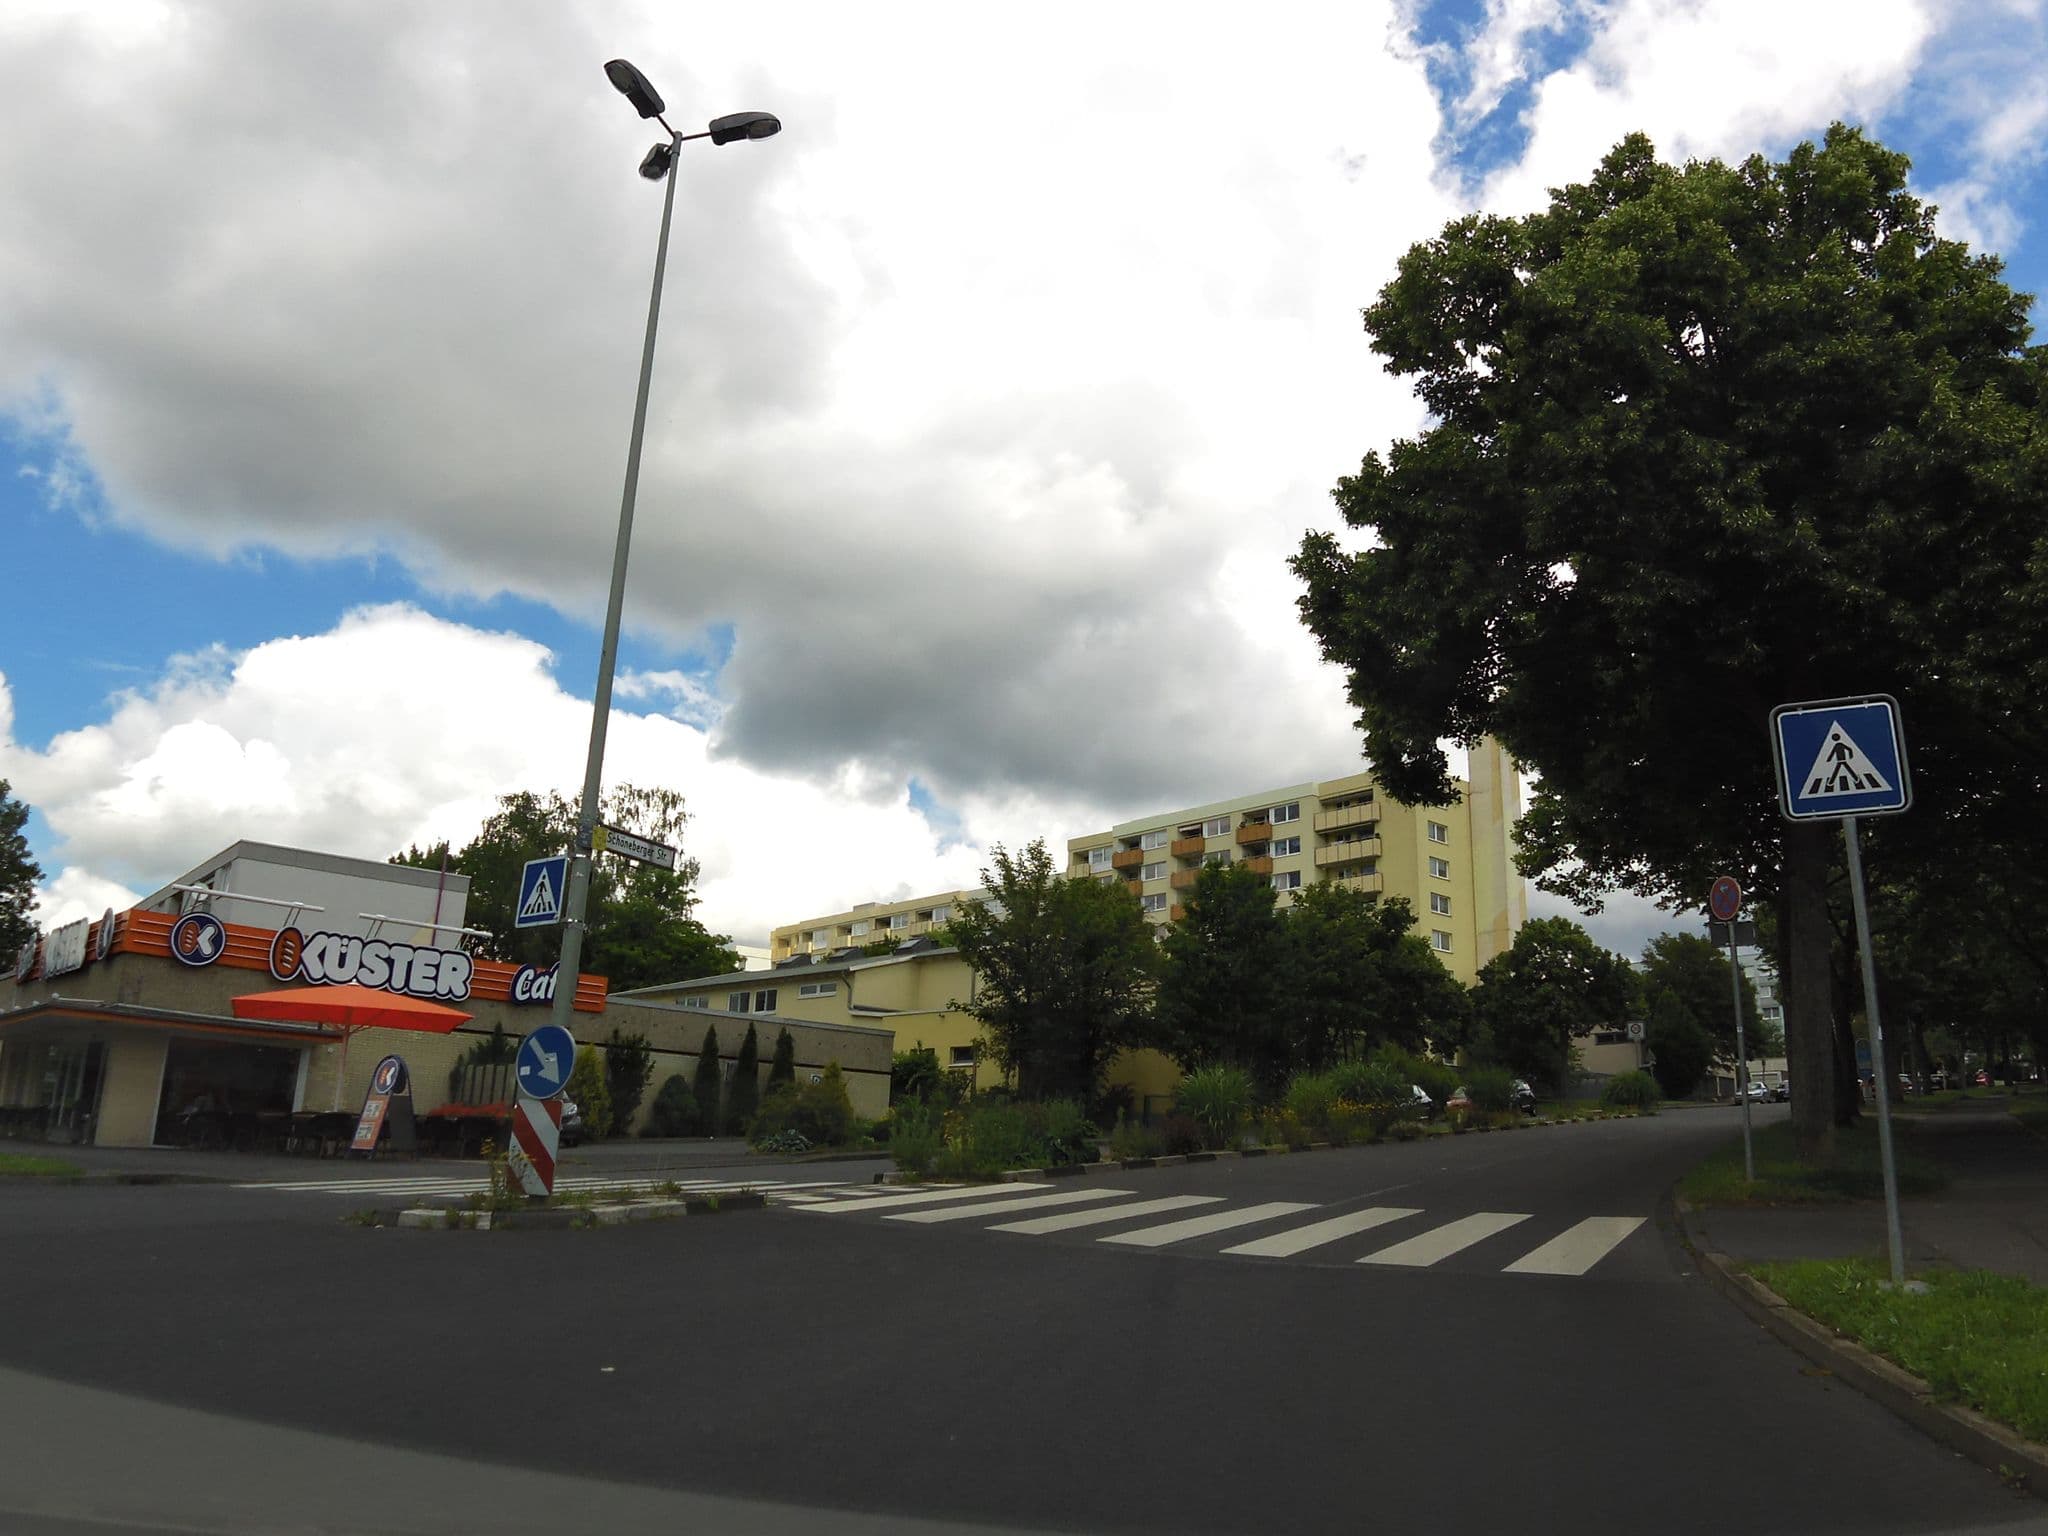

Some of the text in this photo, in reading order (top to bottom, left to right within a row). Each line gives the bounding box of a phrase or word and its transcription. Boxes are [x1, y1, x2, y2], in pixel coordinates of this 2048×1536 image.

[607, 831, 655, 857] Schöneberger
[272, 927, 473, 999] KÜSTER
[515, 968, 559, 1000] Caf
